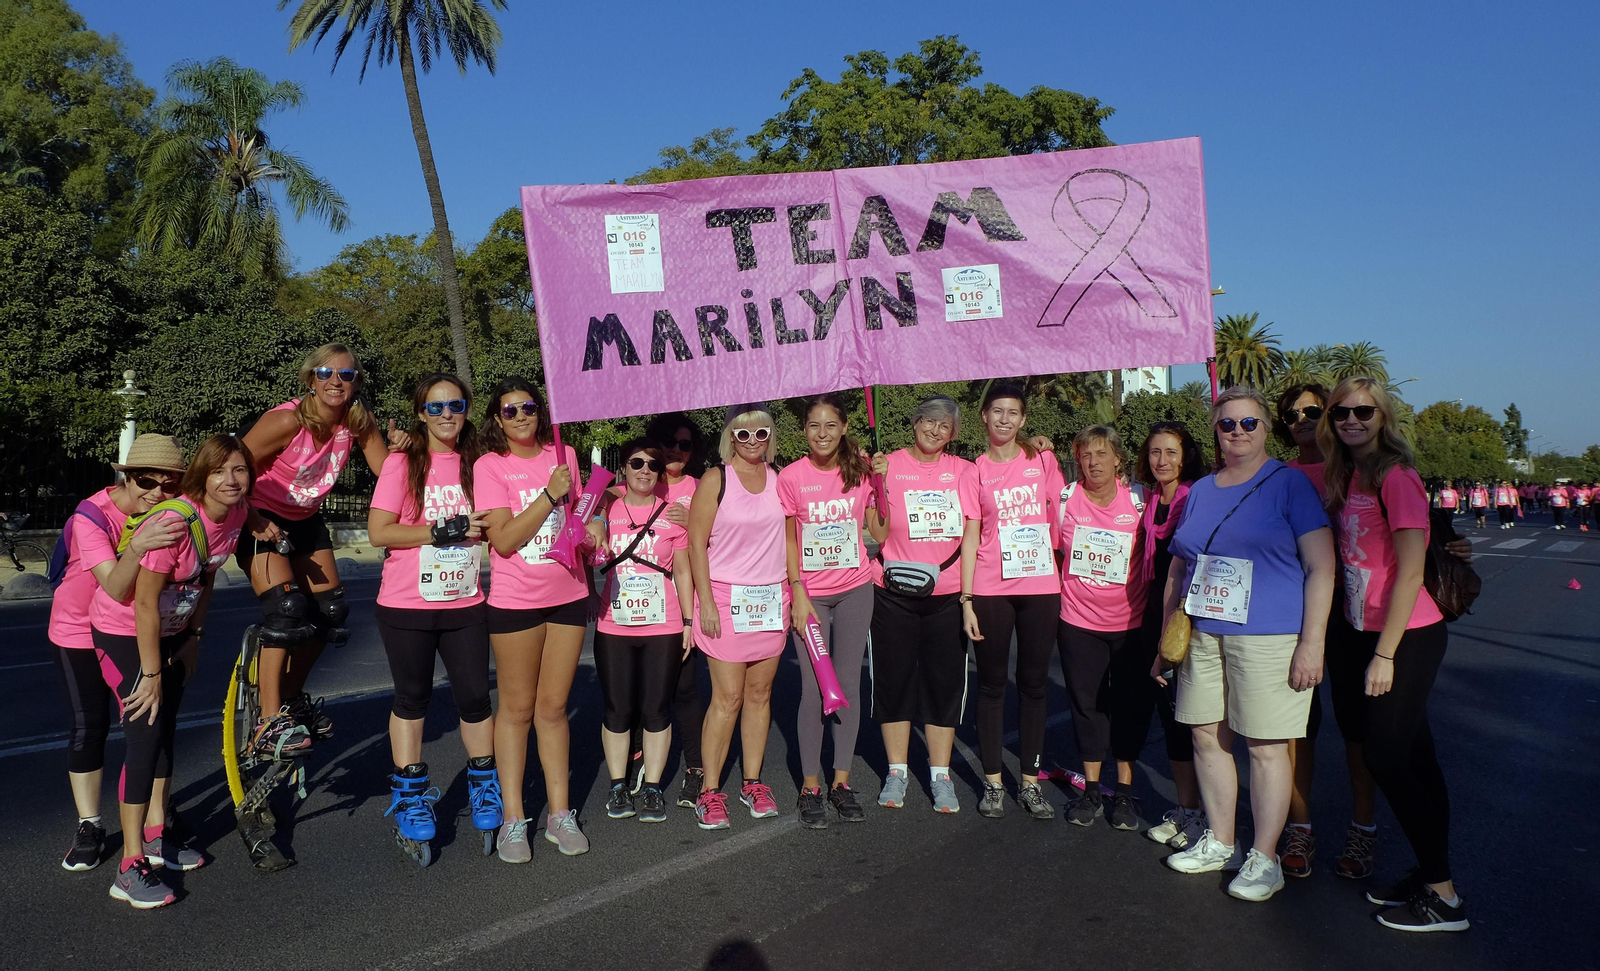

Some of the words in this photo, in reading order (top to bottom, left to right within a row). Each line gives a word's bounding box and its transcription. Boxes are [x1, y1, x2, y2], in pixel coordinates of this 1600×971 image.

[623, 230, 647, 241] 016
[705, 187, 1028, 272] TEAM
[613, 257, 645, 270] TEAM
[960, 290, 983, 302] 016
[993, 483, 1038, 509] HOY
[808, 497, 855, 521] HOY
[998, 503, 1041, 519] GANAN
[924, 511, 947, 521] 016
[819, 545, 842, 555] 016
[1017, 548, 1039, 559] 016
[1088, 551, 1111, 564] 016
[439, 570, 464, 581] 016
[1203, 584, 1229, 598] 016
[626, 598, 649, 609] 016
[1206, 597, 1223, 605] 10143
[745, 603, 767, 613] 016
[810, 623, 829, 655] Ladival
